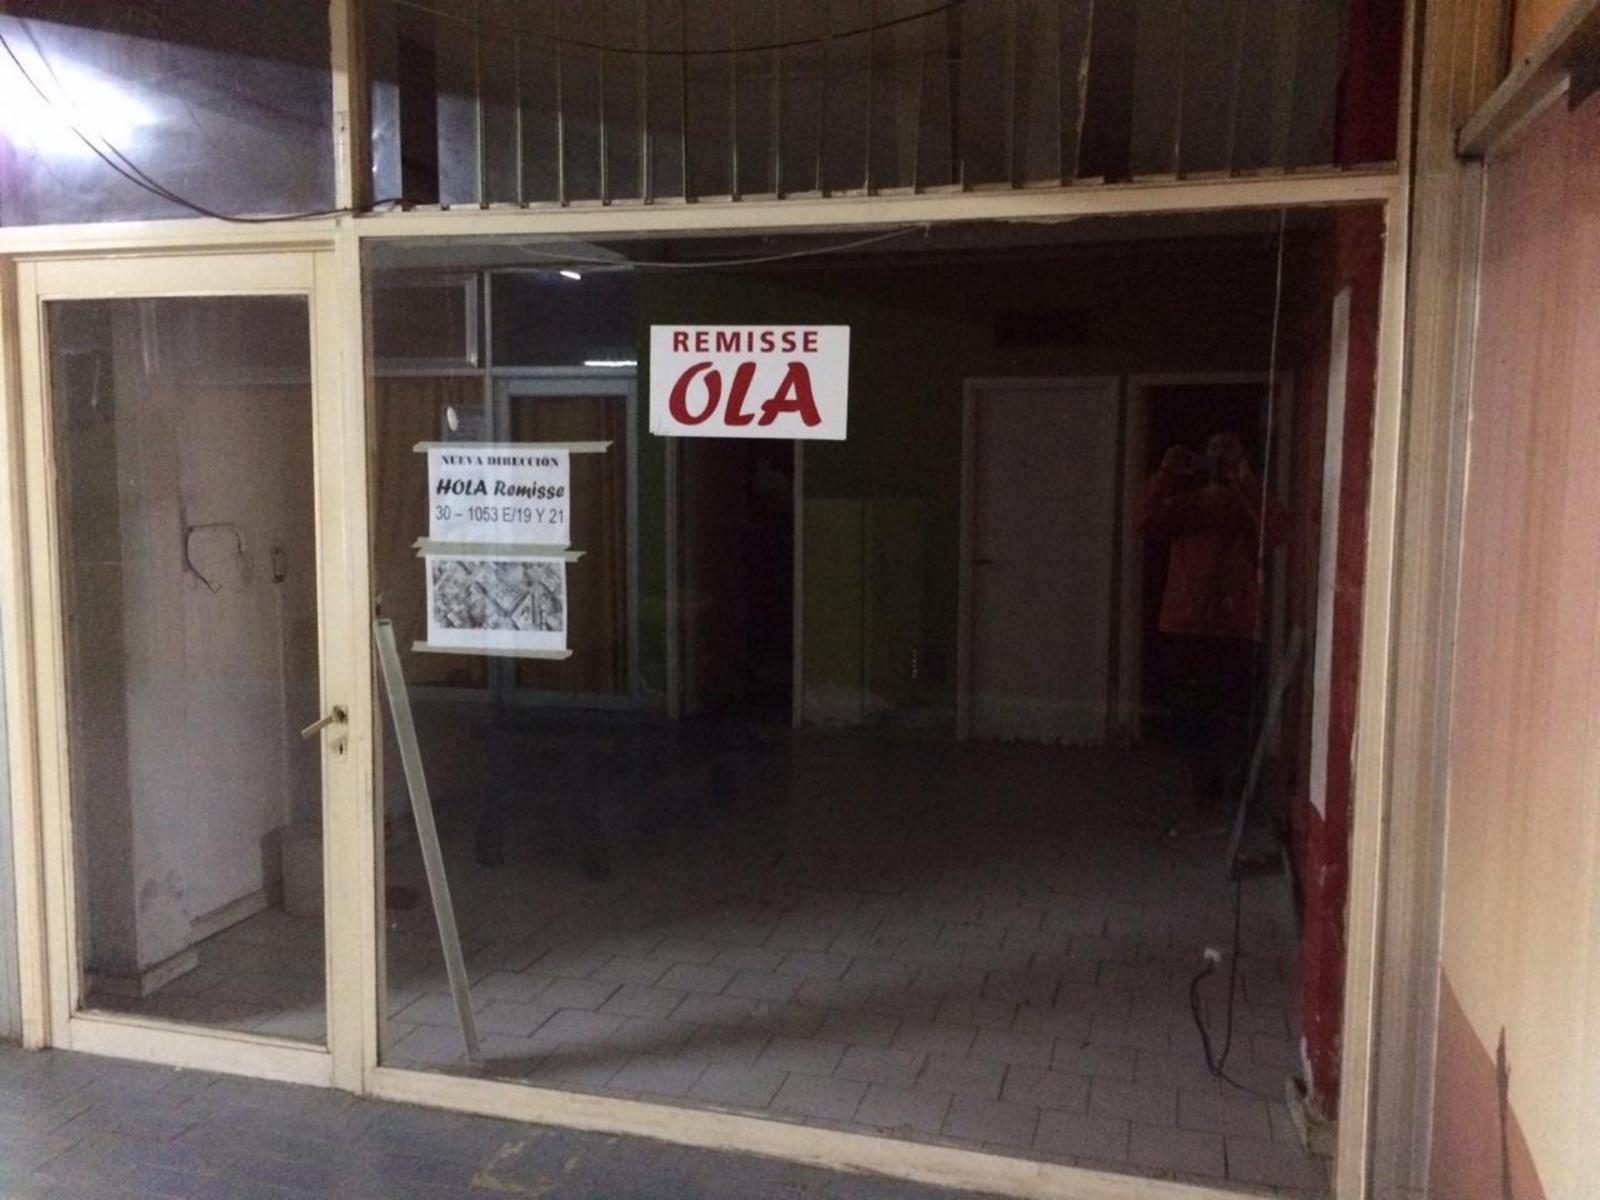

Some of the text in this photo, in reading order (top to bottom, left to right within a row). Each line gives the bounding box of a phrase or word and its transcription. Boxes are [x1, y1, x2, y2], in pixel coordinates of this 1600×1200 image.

[673, 331, 818, 352] REMISSE
[669, 361, 822, 427] OLA
[441, 455, 483, 466] NUEVA
[436, 479, 565, 499] HOLA Remisse
[435, 505, 451, 521] 30
[468, 506, 498, 521] 1053
[503, 507, 532, 523] E/19
[536, 508, 546, 523] Y
[549, 509, 564, 524] 21
